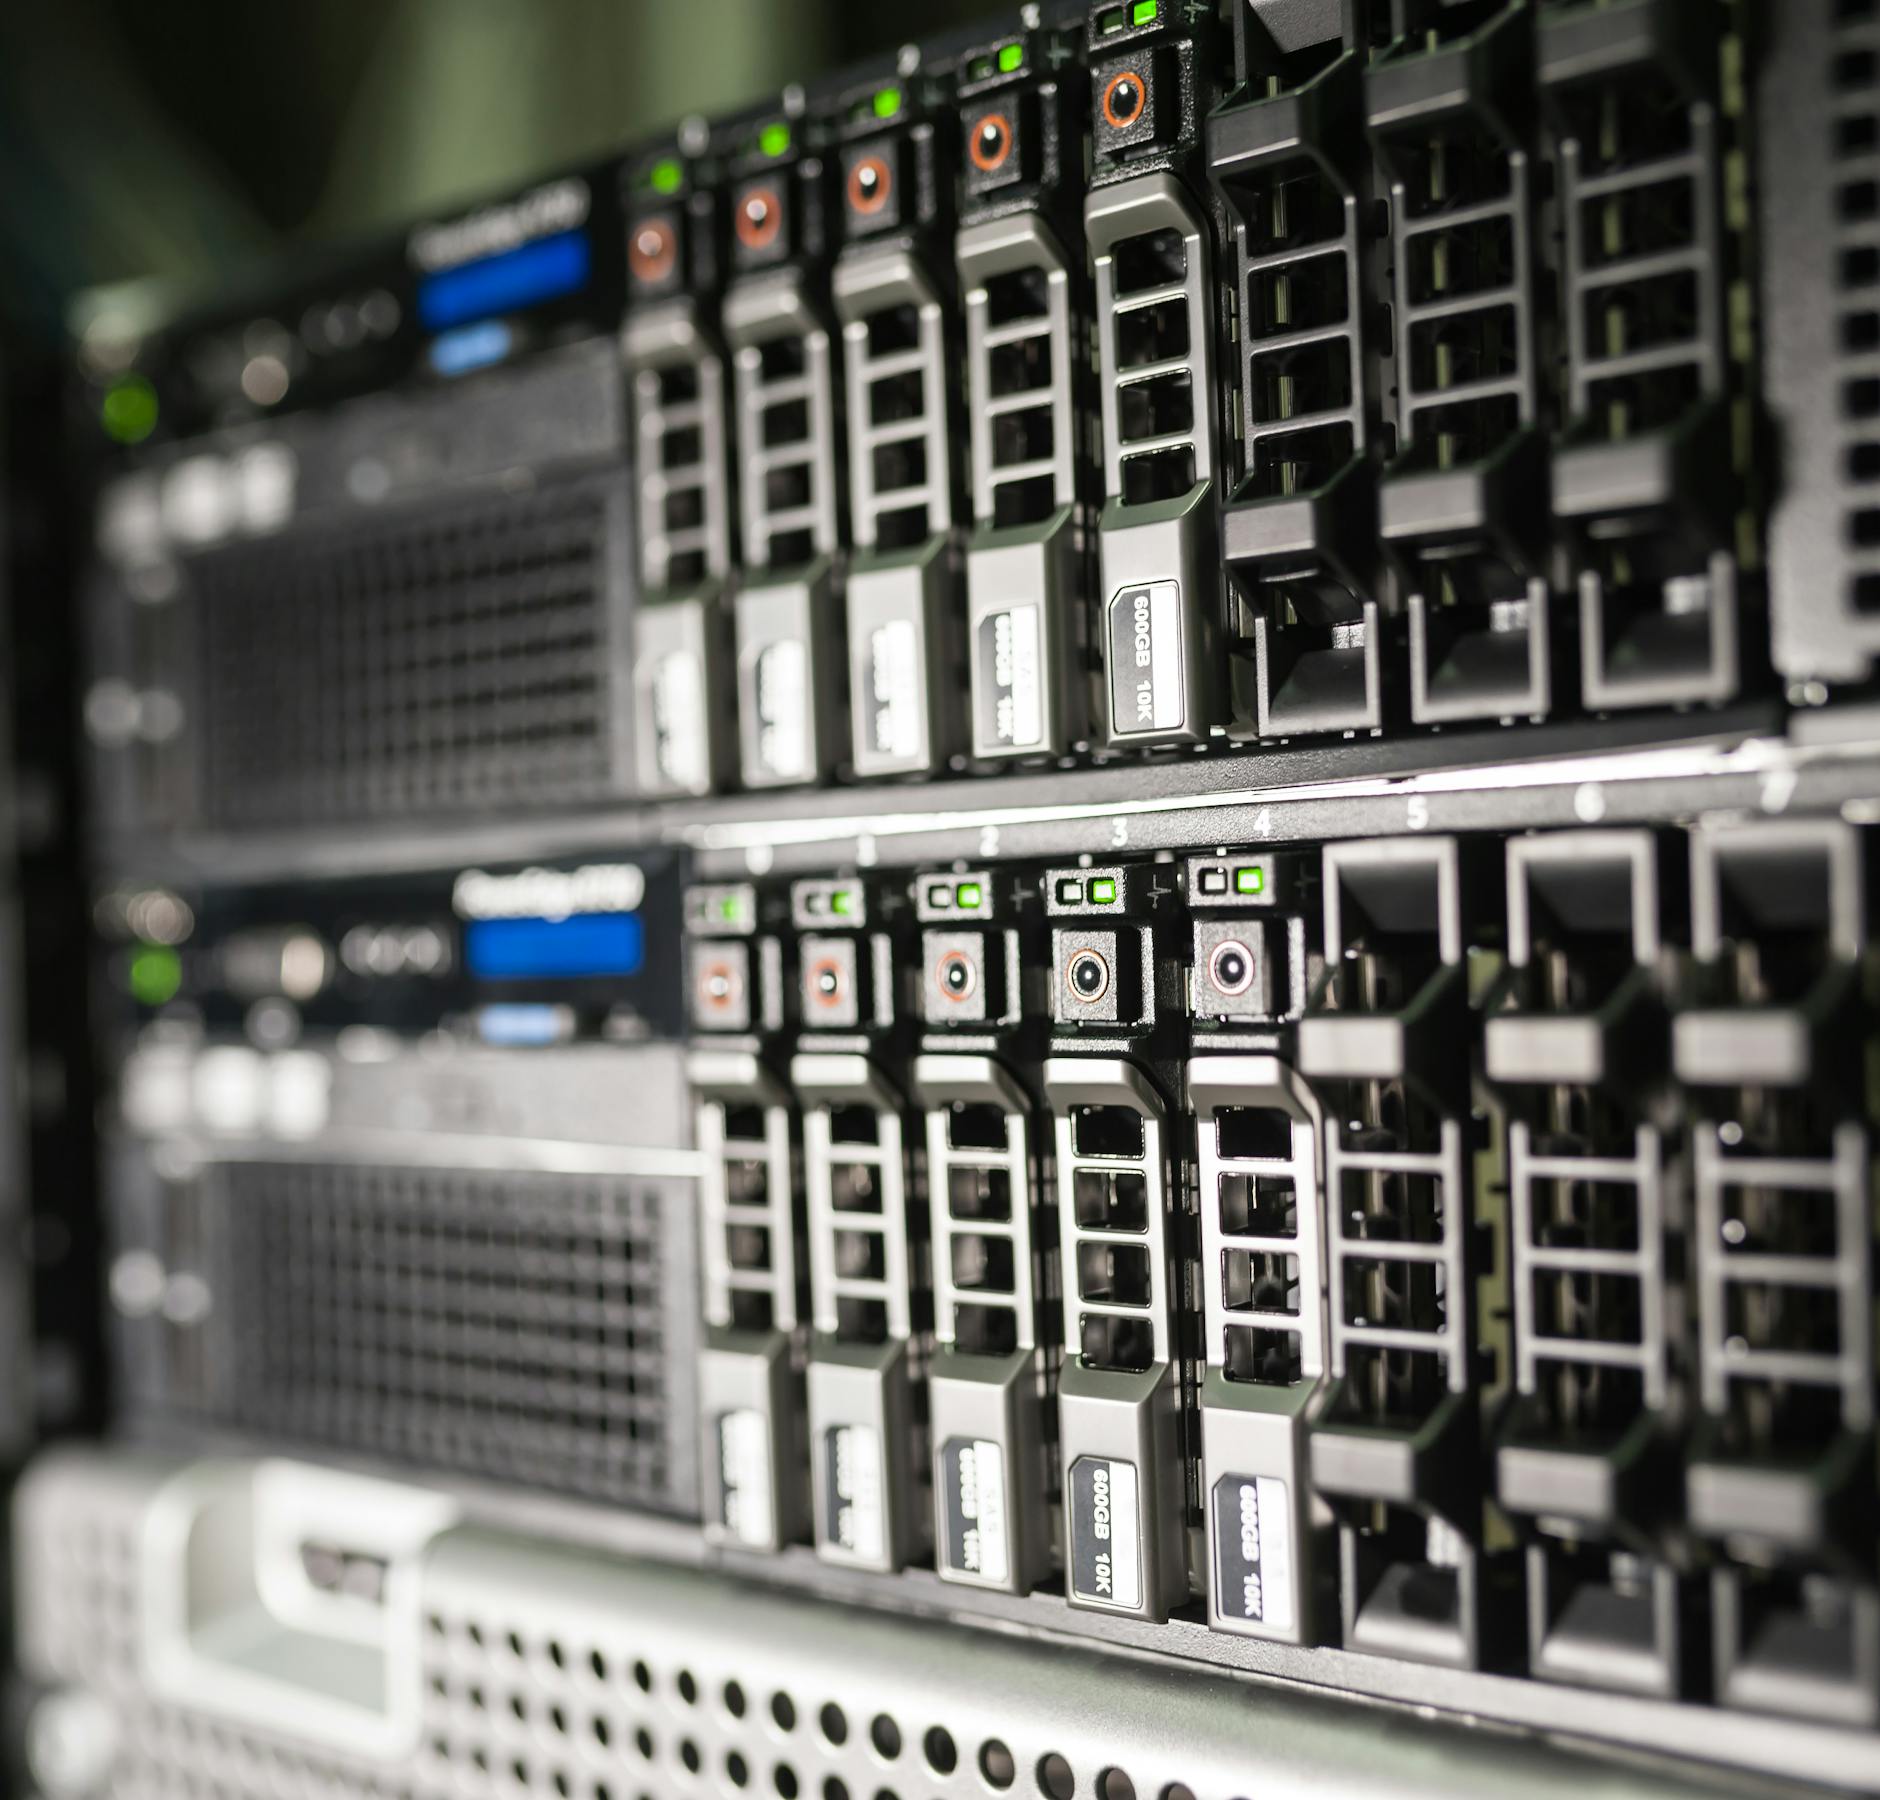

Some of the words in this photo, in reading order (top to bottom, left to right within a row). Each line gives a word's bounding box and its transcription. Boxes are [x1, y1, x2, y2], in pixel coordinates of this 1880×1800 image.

[1133, 595, 1151, 668] 600GB
[1136, 679, 1152, 722] 10K
[1111, 817, 1128, 847] 3
[1252, 808, 1271, 837] 4
[1407, 795, 1428, 830] 5
[1093, 1468, 1110, 1540] 600GB
[1239, 1484, 1260, 1562] 600GB
[1095, 1552, 1112, 1594] 10K
[1243, 1572, 1262, 1618] 10K
